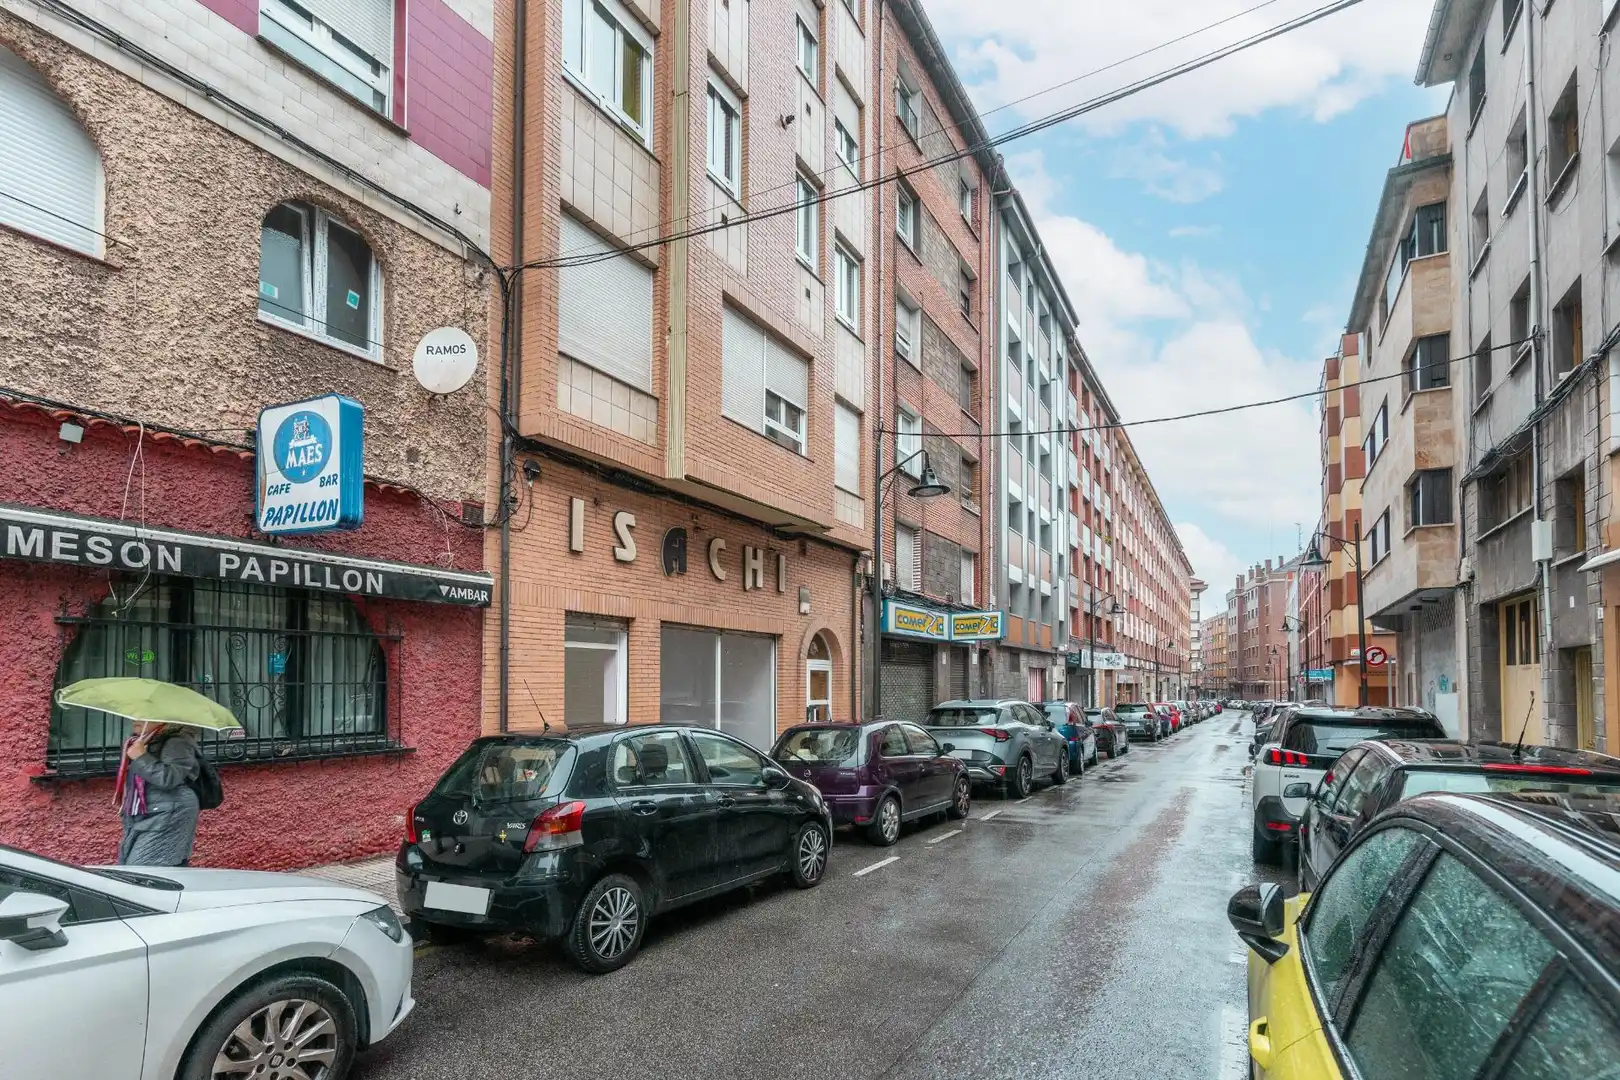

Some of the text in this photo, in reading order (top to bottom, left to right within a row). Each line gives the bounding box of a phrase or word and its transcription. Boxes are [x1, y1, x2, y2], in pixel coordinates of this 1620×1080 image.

[426, 344, 466, 355] RAMOS
[286, 443, 323, 469] MAES
[267, 473, 338, 496] CAFE BAR
[263, 498, 339, 527] PAPILLON
[570, 497, 786, 593] ISACHI
[7, 525, 383, 594] MESON PAPILLON
[449, 587, 489, 601] AMBAR
